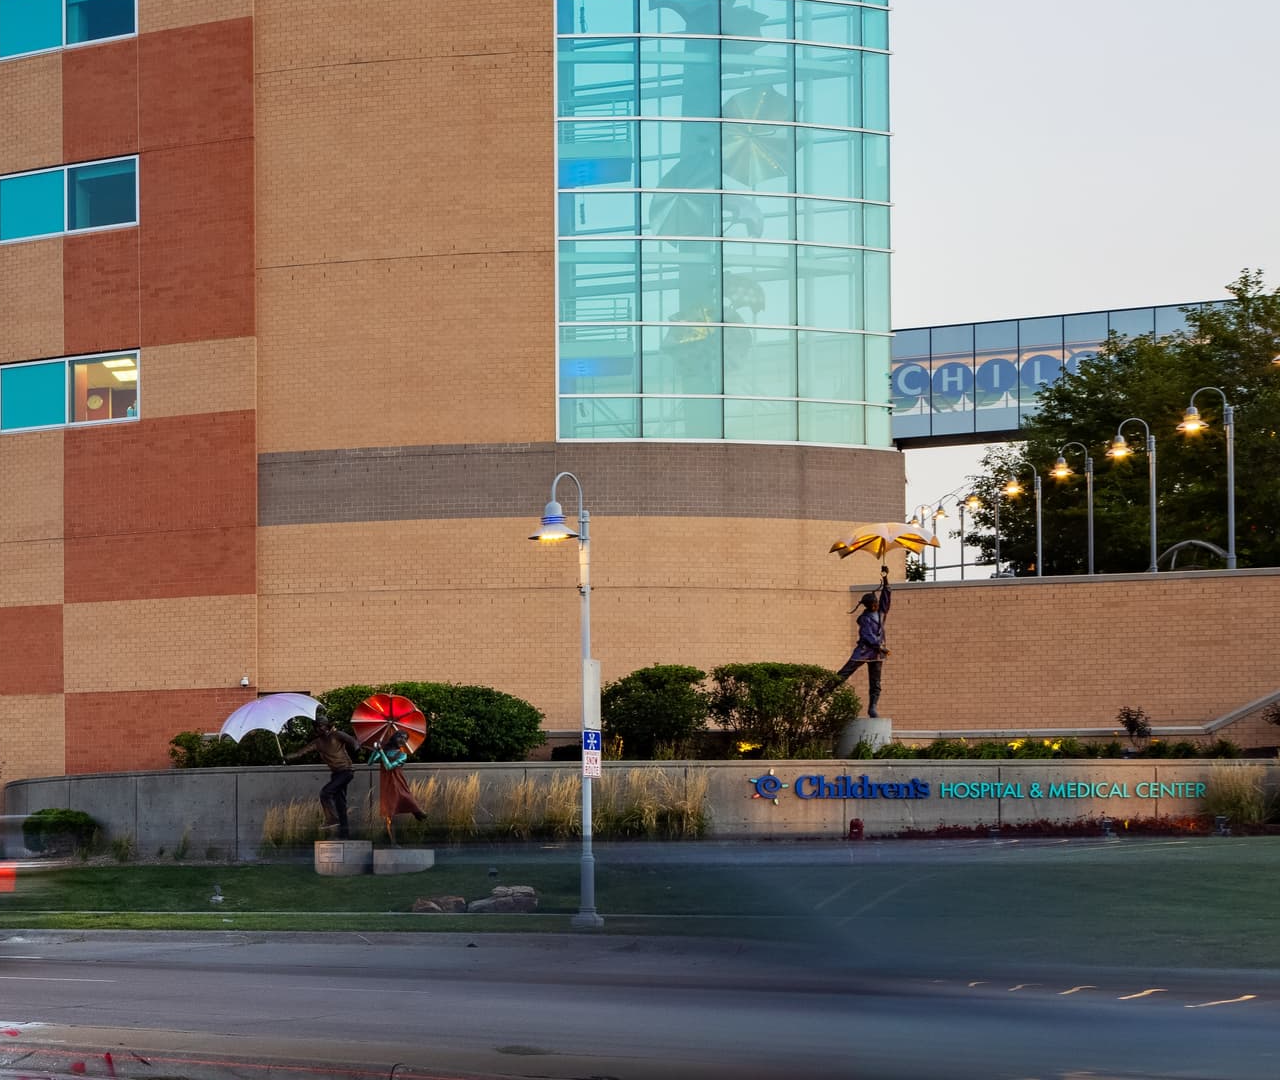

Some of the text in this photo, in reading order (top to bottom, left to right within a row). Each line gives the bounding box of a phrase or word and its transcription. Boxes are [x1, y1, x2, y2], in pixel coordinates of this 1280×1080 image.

[794, 774, 1207, 799] Children's HOSPITAL & MEDICAL CENTER
